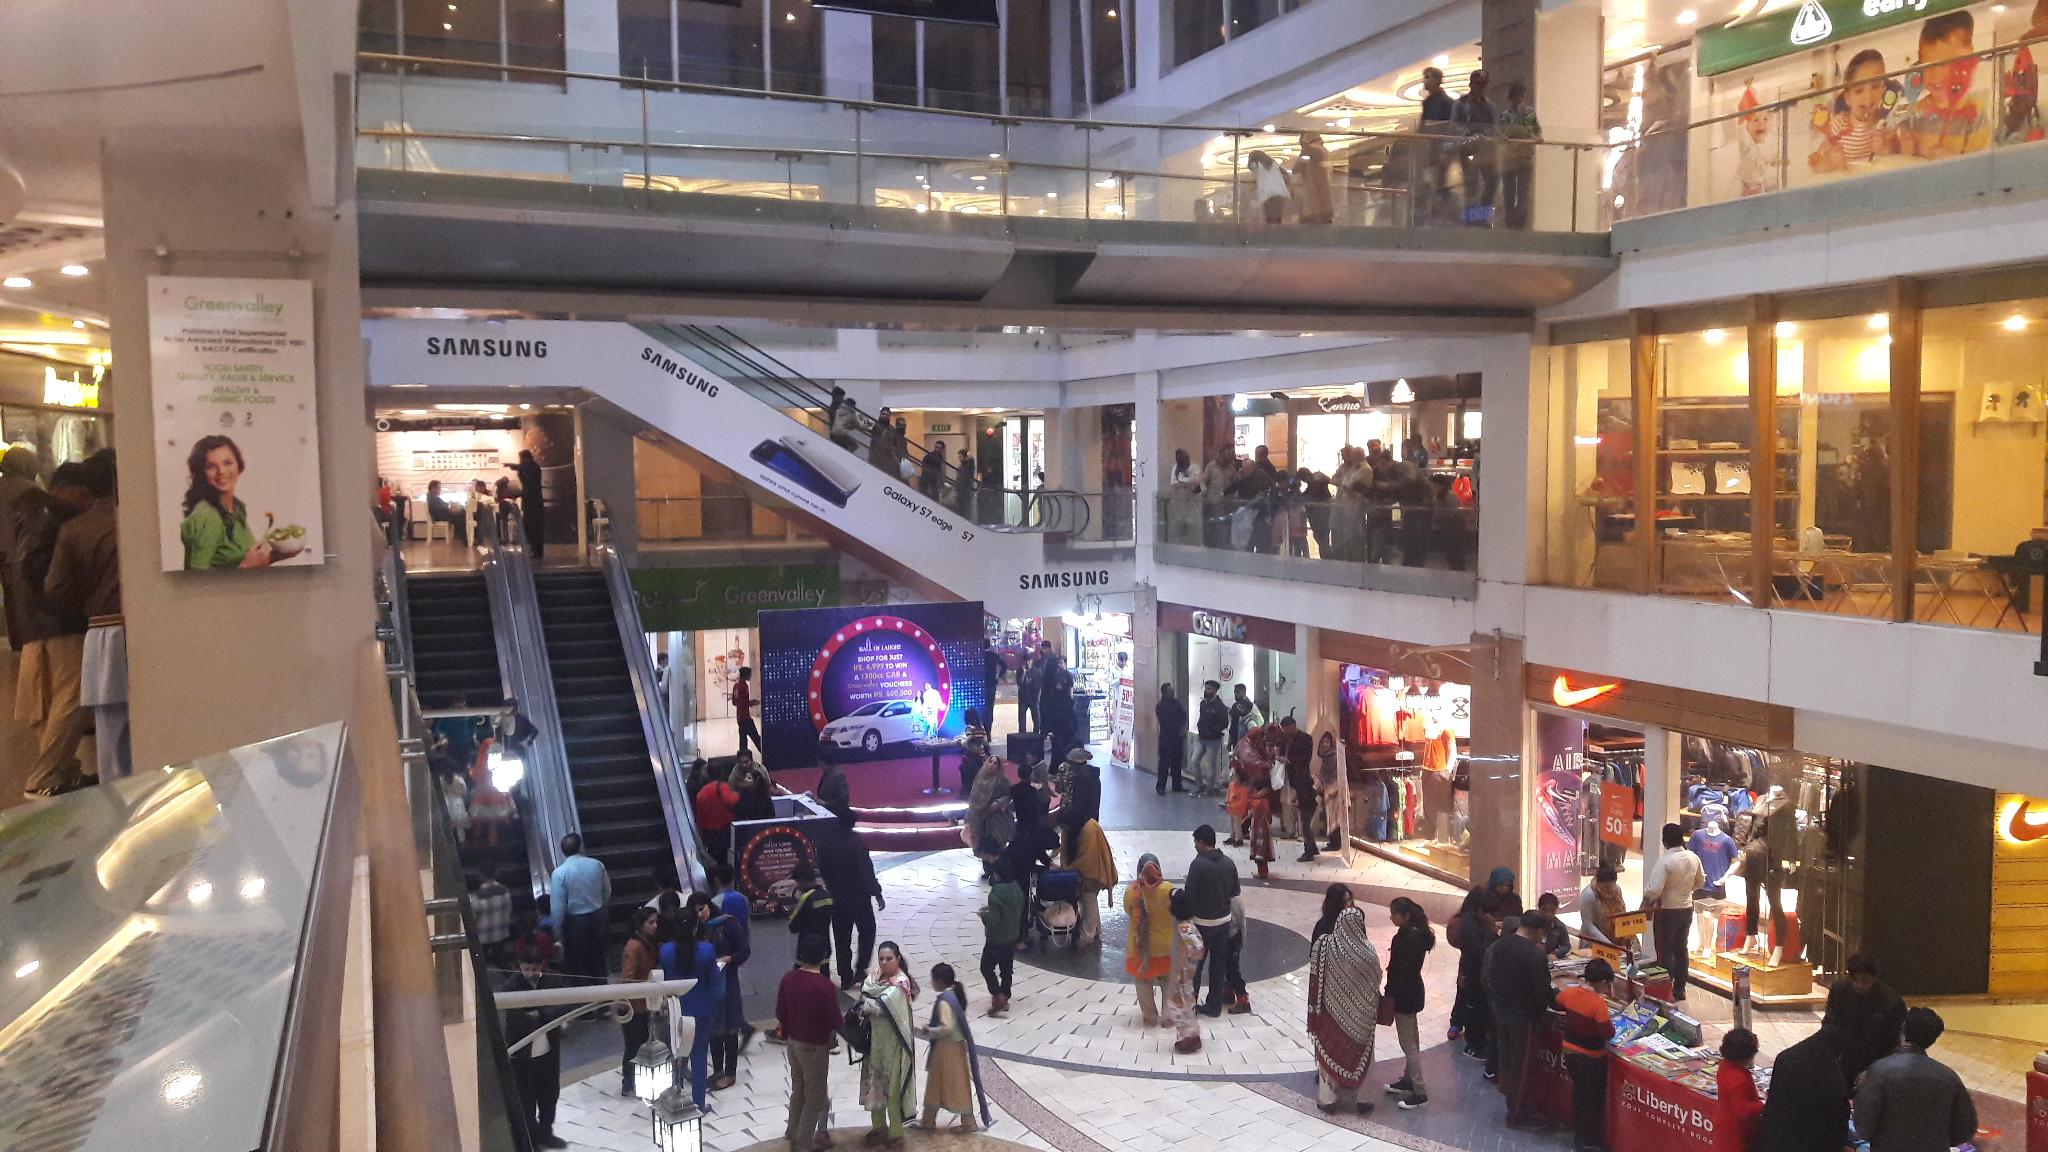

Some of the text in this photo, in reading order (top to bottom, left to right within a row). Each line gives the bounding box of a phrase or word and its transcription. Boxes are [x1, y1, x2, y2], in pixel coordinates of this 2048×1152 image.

[184, 293, 284, 316] Greenvalley
[427, 337, 548, 358] SAMSUNG
[204, 364, 231, 372] FOOD
[641, 347, 720, 399] SAMSUNG
[260, 375, 295, 383] SERVICE
[213, 386, 251, 394] HEALTHY
[244, 396, 276, 404] FOODS
[883, 486, 975, 542] Galaxy S7 edge S7
[1019, 570, 1109, 590] SAMSUNG
[725, 578, 826, 608] Greenvalley
[1192, 610, 1234, 639] OSIM
[857, 655, 874, 663] SHOP
[875, 654, 888, 662] FOR
[880, 680, 912, 688] VOUCHERS
[849, 692, 872, 700] WORTH
[1552, 752, 1583, 772] AIR
[1636, 1086, 1689, 1124] Liberty
[1621, 1100, 1714, 1145] YOUR COMPLETE BOOK
